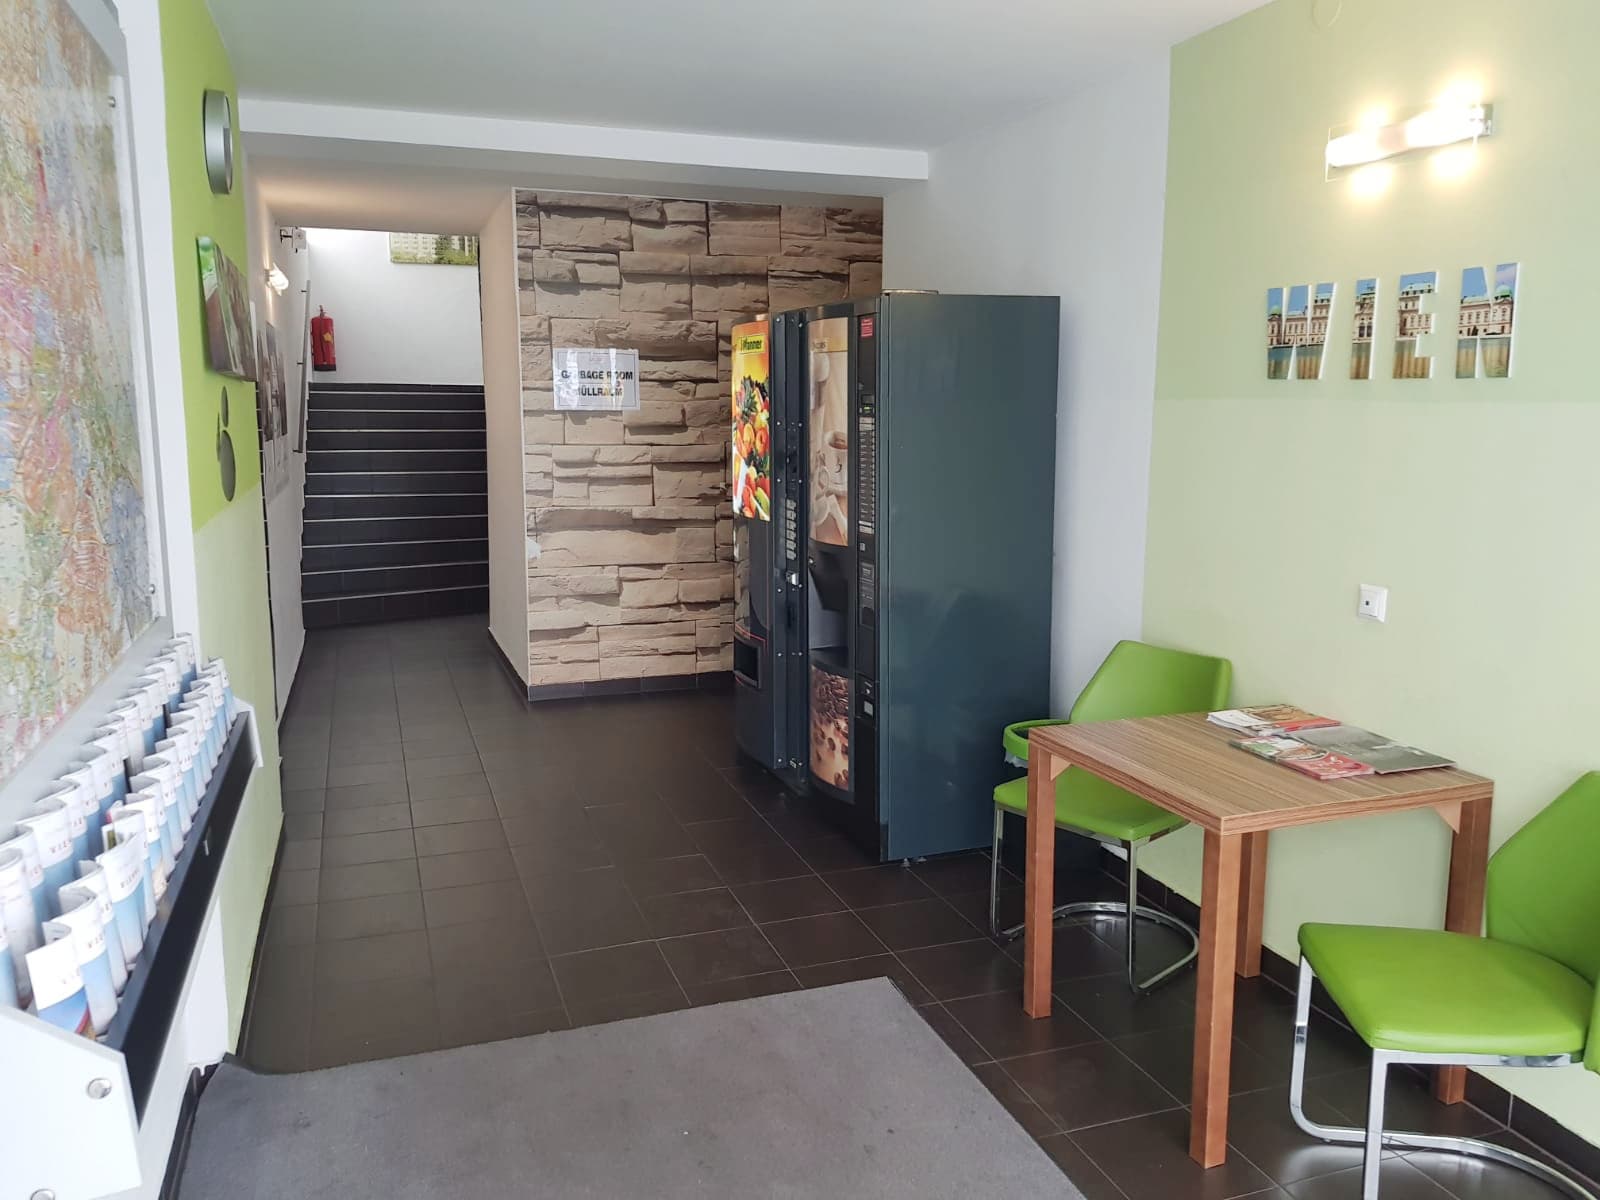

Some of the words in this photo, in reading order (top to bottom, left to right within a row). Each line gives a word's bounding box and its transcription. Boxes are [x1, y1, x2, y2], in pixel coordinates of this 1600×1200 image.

[1266, 262, 1520, 381] WIEN
[561, 370, 604, 380] GBAGE
[574, 384, 623, 397] ÜLLRAM
